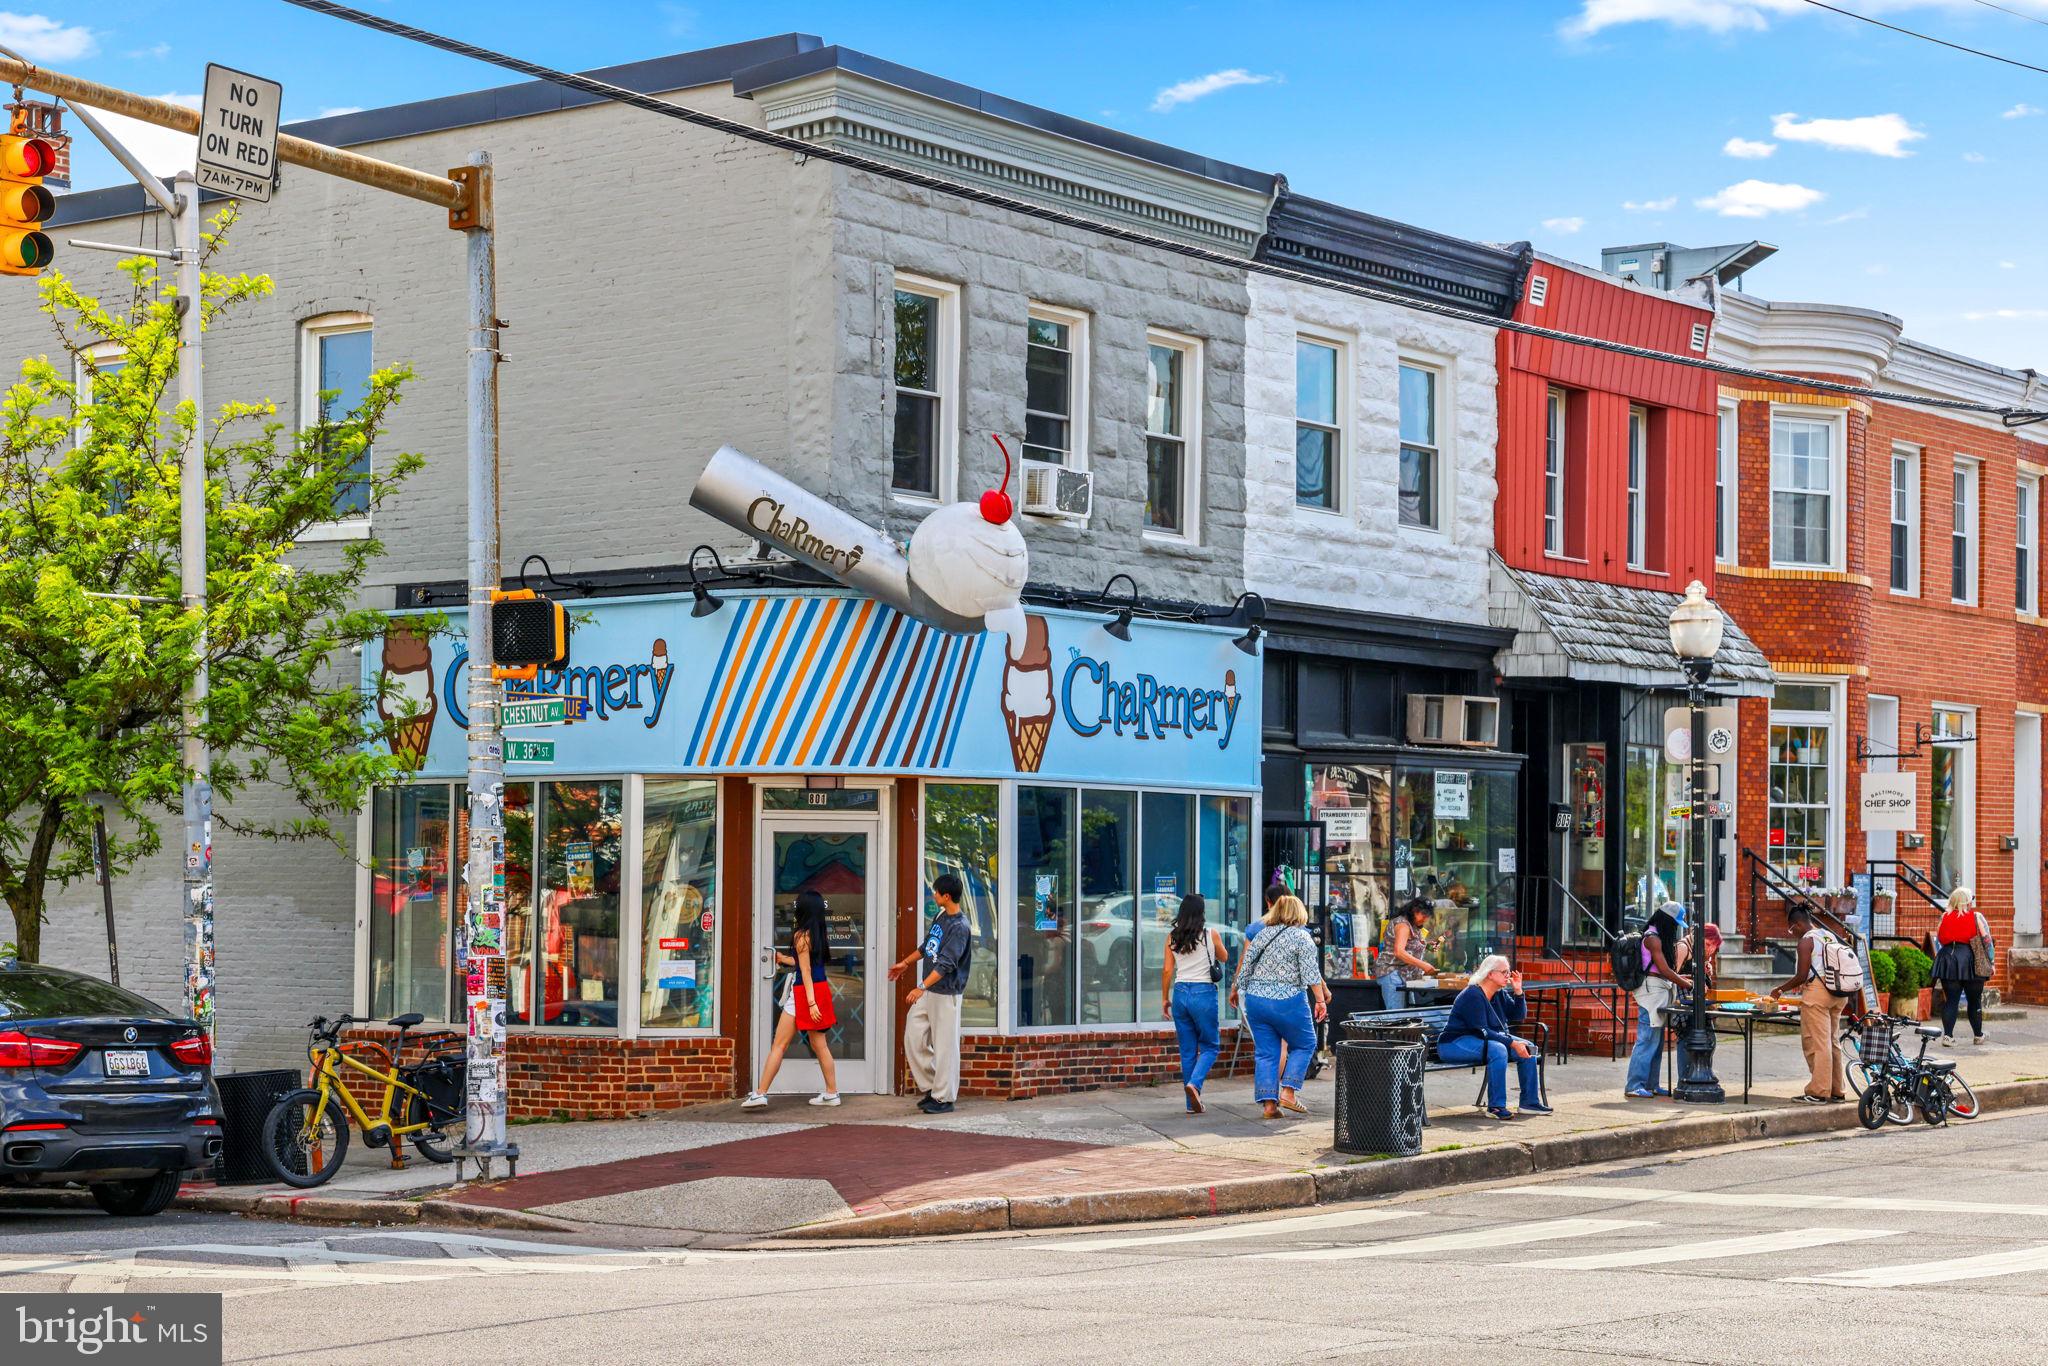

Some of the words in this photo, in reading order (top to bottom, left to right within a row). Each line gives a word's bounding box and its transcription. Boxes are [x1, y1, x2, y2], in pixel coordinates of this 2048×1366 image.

[230, 83, 258, 107] NO
[219, 108, 263, 138] TURN
[206, 133, 229, 156] ON
[236, 141, 269, 166] RED
[203, 169, 263, 194] 7AM-7PM
[452, 642, 468, 656] The
[1068, 646, 1082, 660] The
[503, 704, 549, 724] CHESTNUT
[550, 706, 561, 718] AV.
[507, 742, 519, 759] W.
[541, 746, 550, 757] ST.
[809, 793, 826, 804] 801
[1864, 799, 1887, 808] CHEF
[1888, 799, 1911, 807] SHOP
[1556, 814, 1571, 827] 805
